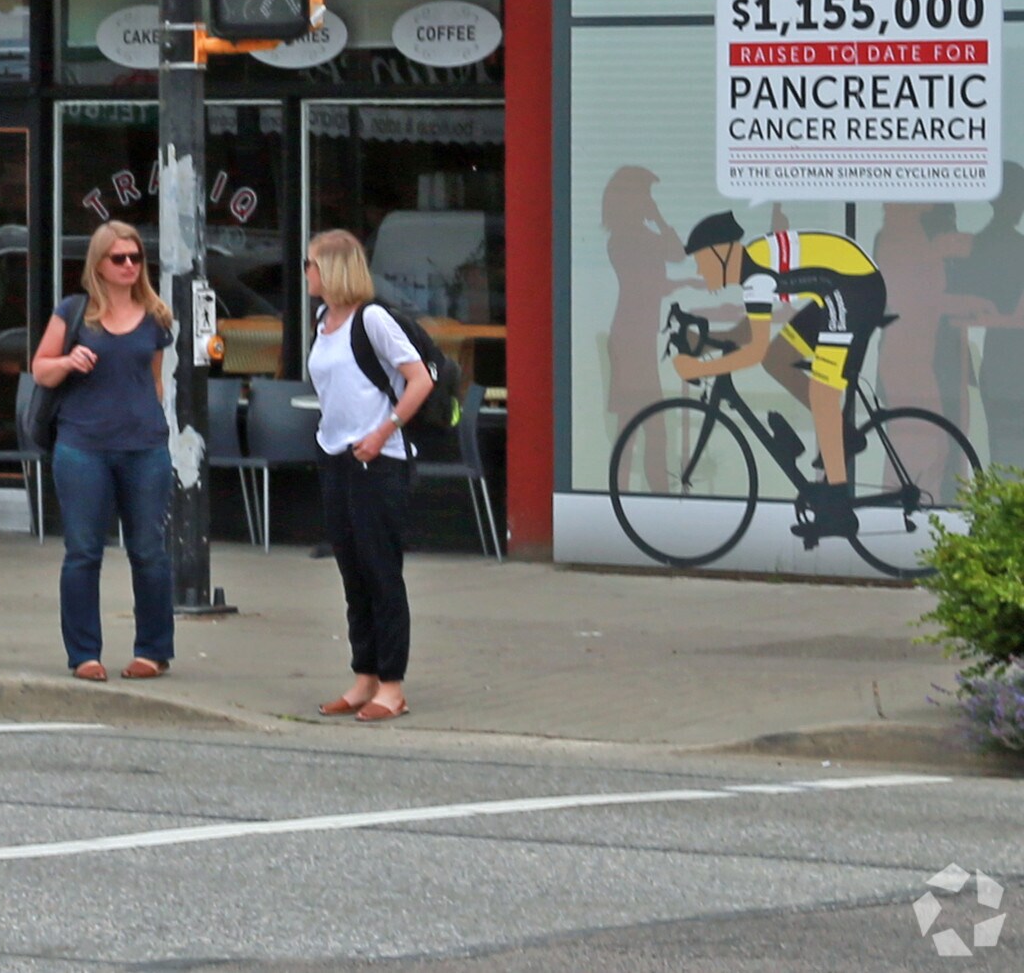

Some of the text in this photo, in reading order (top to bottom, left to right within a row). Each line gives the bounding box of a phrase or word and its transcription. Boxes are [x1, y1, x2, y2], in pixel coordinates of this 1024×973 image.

[122, 29, 160, 45] CAKE
[416, 25, 476, 43] COFFEE
[740, 43, 977, 64] RAISED TO DATE FOR
[730, 74, 987, 109] PANCREATIC
[729, 117, 987, 141] CANCER RESEARCH
[729, 166, 986, 178] BY THE GLOTMAN SIMPSON CYCLING CLUB
[82, 160, 258, 222] TRAIQ
